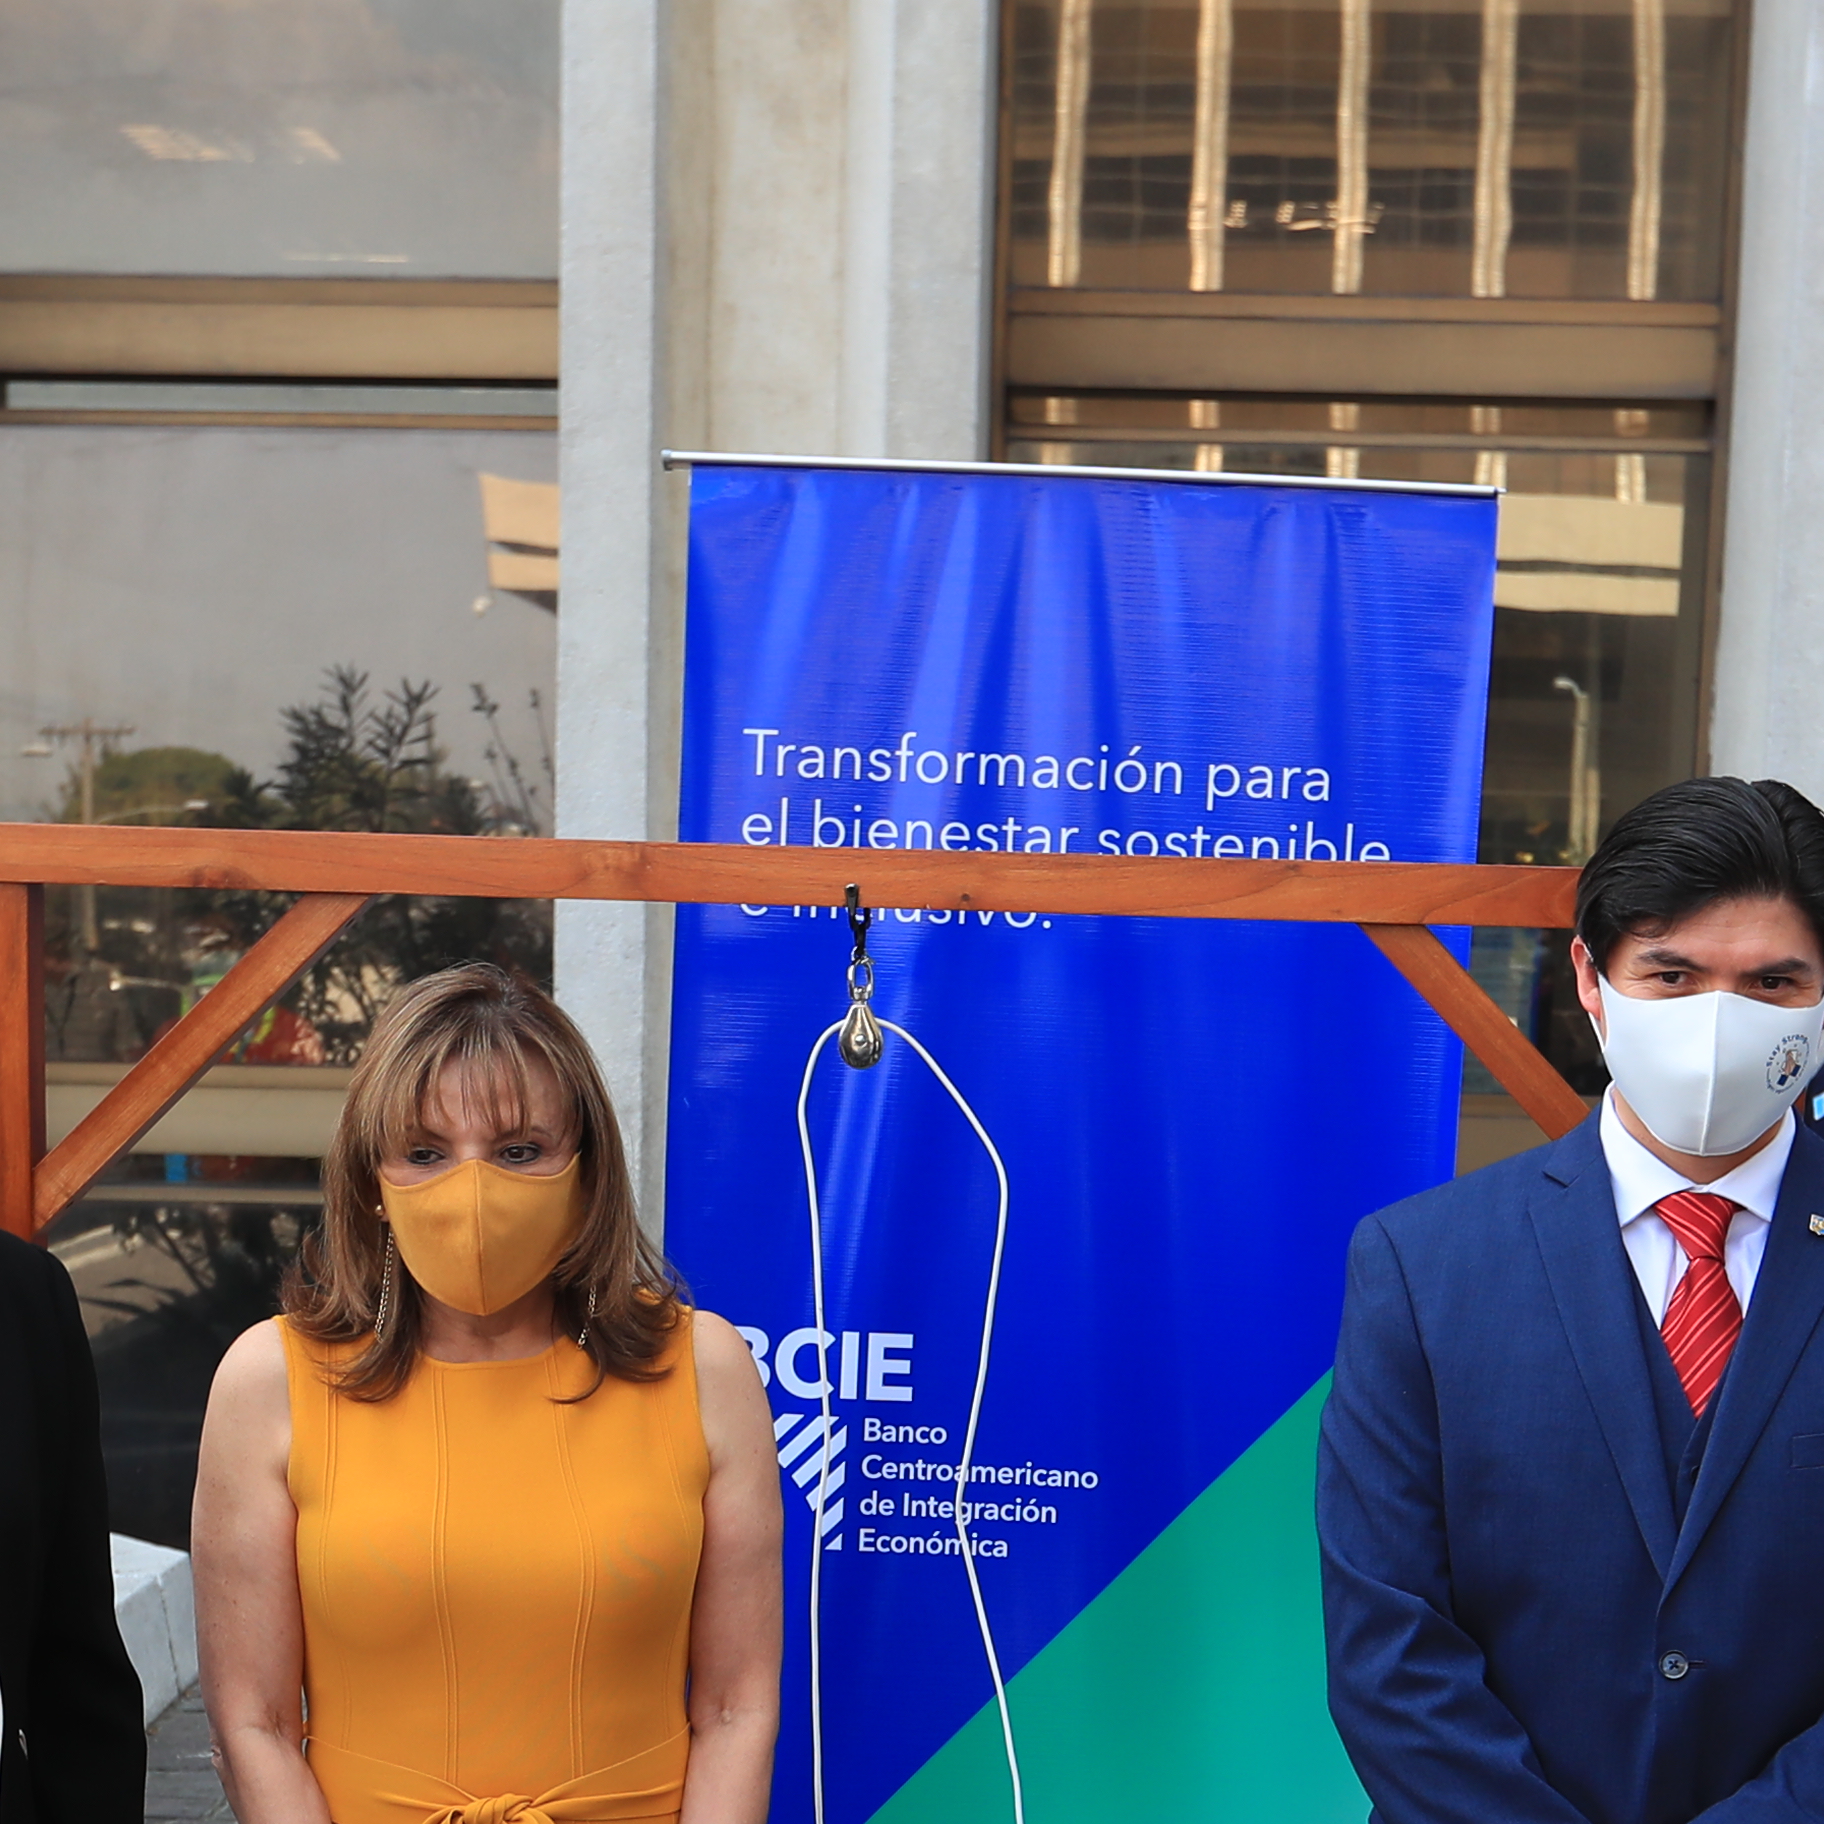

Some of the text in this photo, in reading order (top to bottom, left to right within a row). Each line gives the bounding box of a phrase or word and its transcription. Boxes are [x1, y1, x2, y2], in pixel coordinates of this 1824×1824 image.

[742, 728, 1331, 811] Transformación para
[741, 797, 1079, 853] el bienestar
[1098, 820, 1391, 862] sostenible
[863, 1418, 947, 1445] Banco
[861, 1455, 1099, 1489] Centroamericano
[859, 1490, 1057, 1526] de Integración
[858, 1527, 1009, 1559] Económica
